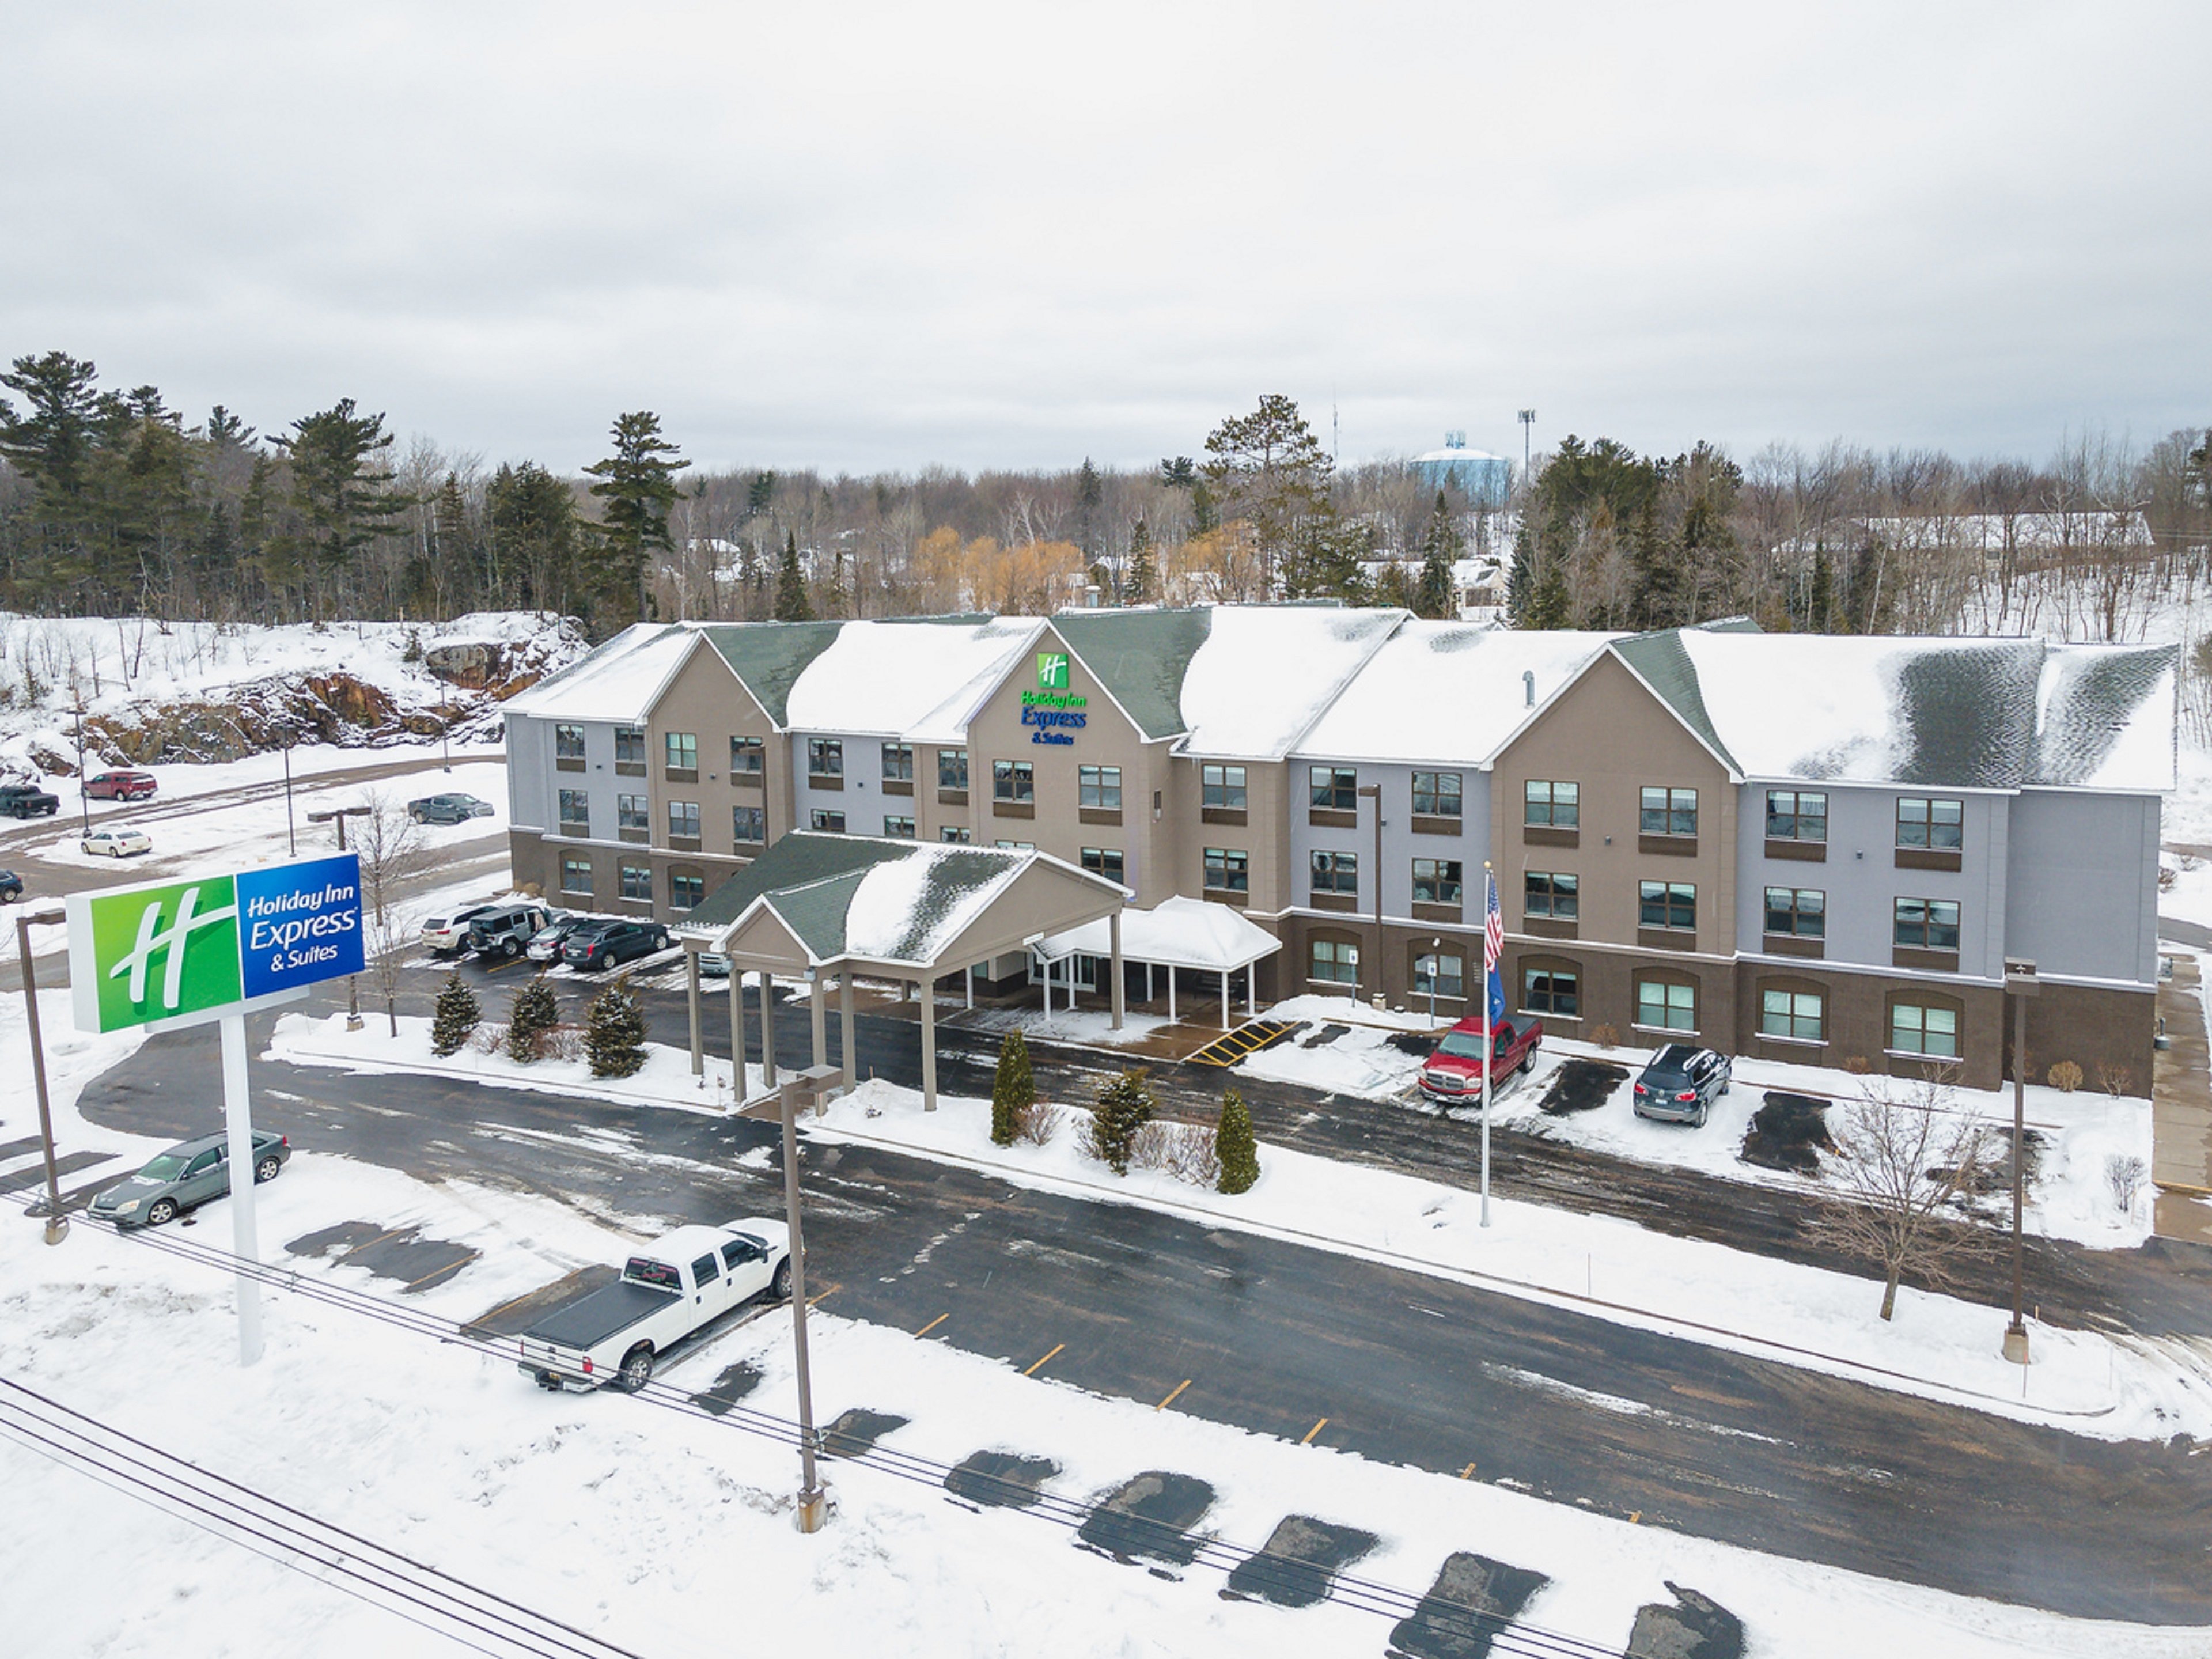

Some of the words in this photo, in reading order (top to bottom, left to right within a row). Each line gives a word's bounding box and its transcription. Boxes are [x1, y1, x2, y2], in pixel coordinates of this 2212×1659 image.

[1021, 691, 1066, 709] Holiday
[1066, 692, 1086, 707] Inn
[1021, 706, 1087, 730] Express
[1032, 732, 1041, 744] &
[1041, 732, 1074, 745] Suites
[248, 890, 323, 918] Holiday
[325, 884, 354, 903] Inn
[250, 910, 355, 950] Express
[271, 954, 283, 972] &
[287, 945, 338, 968] Suites
